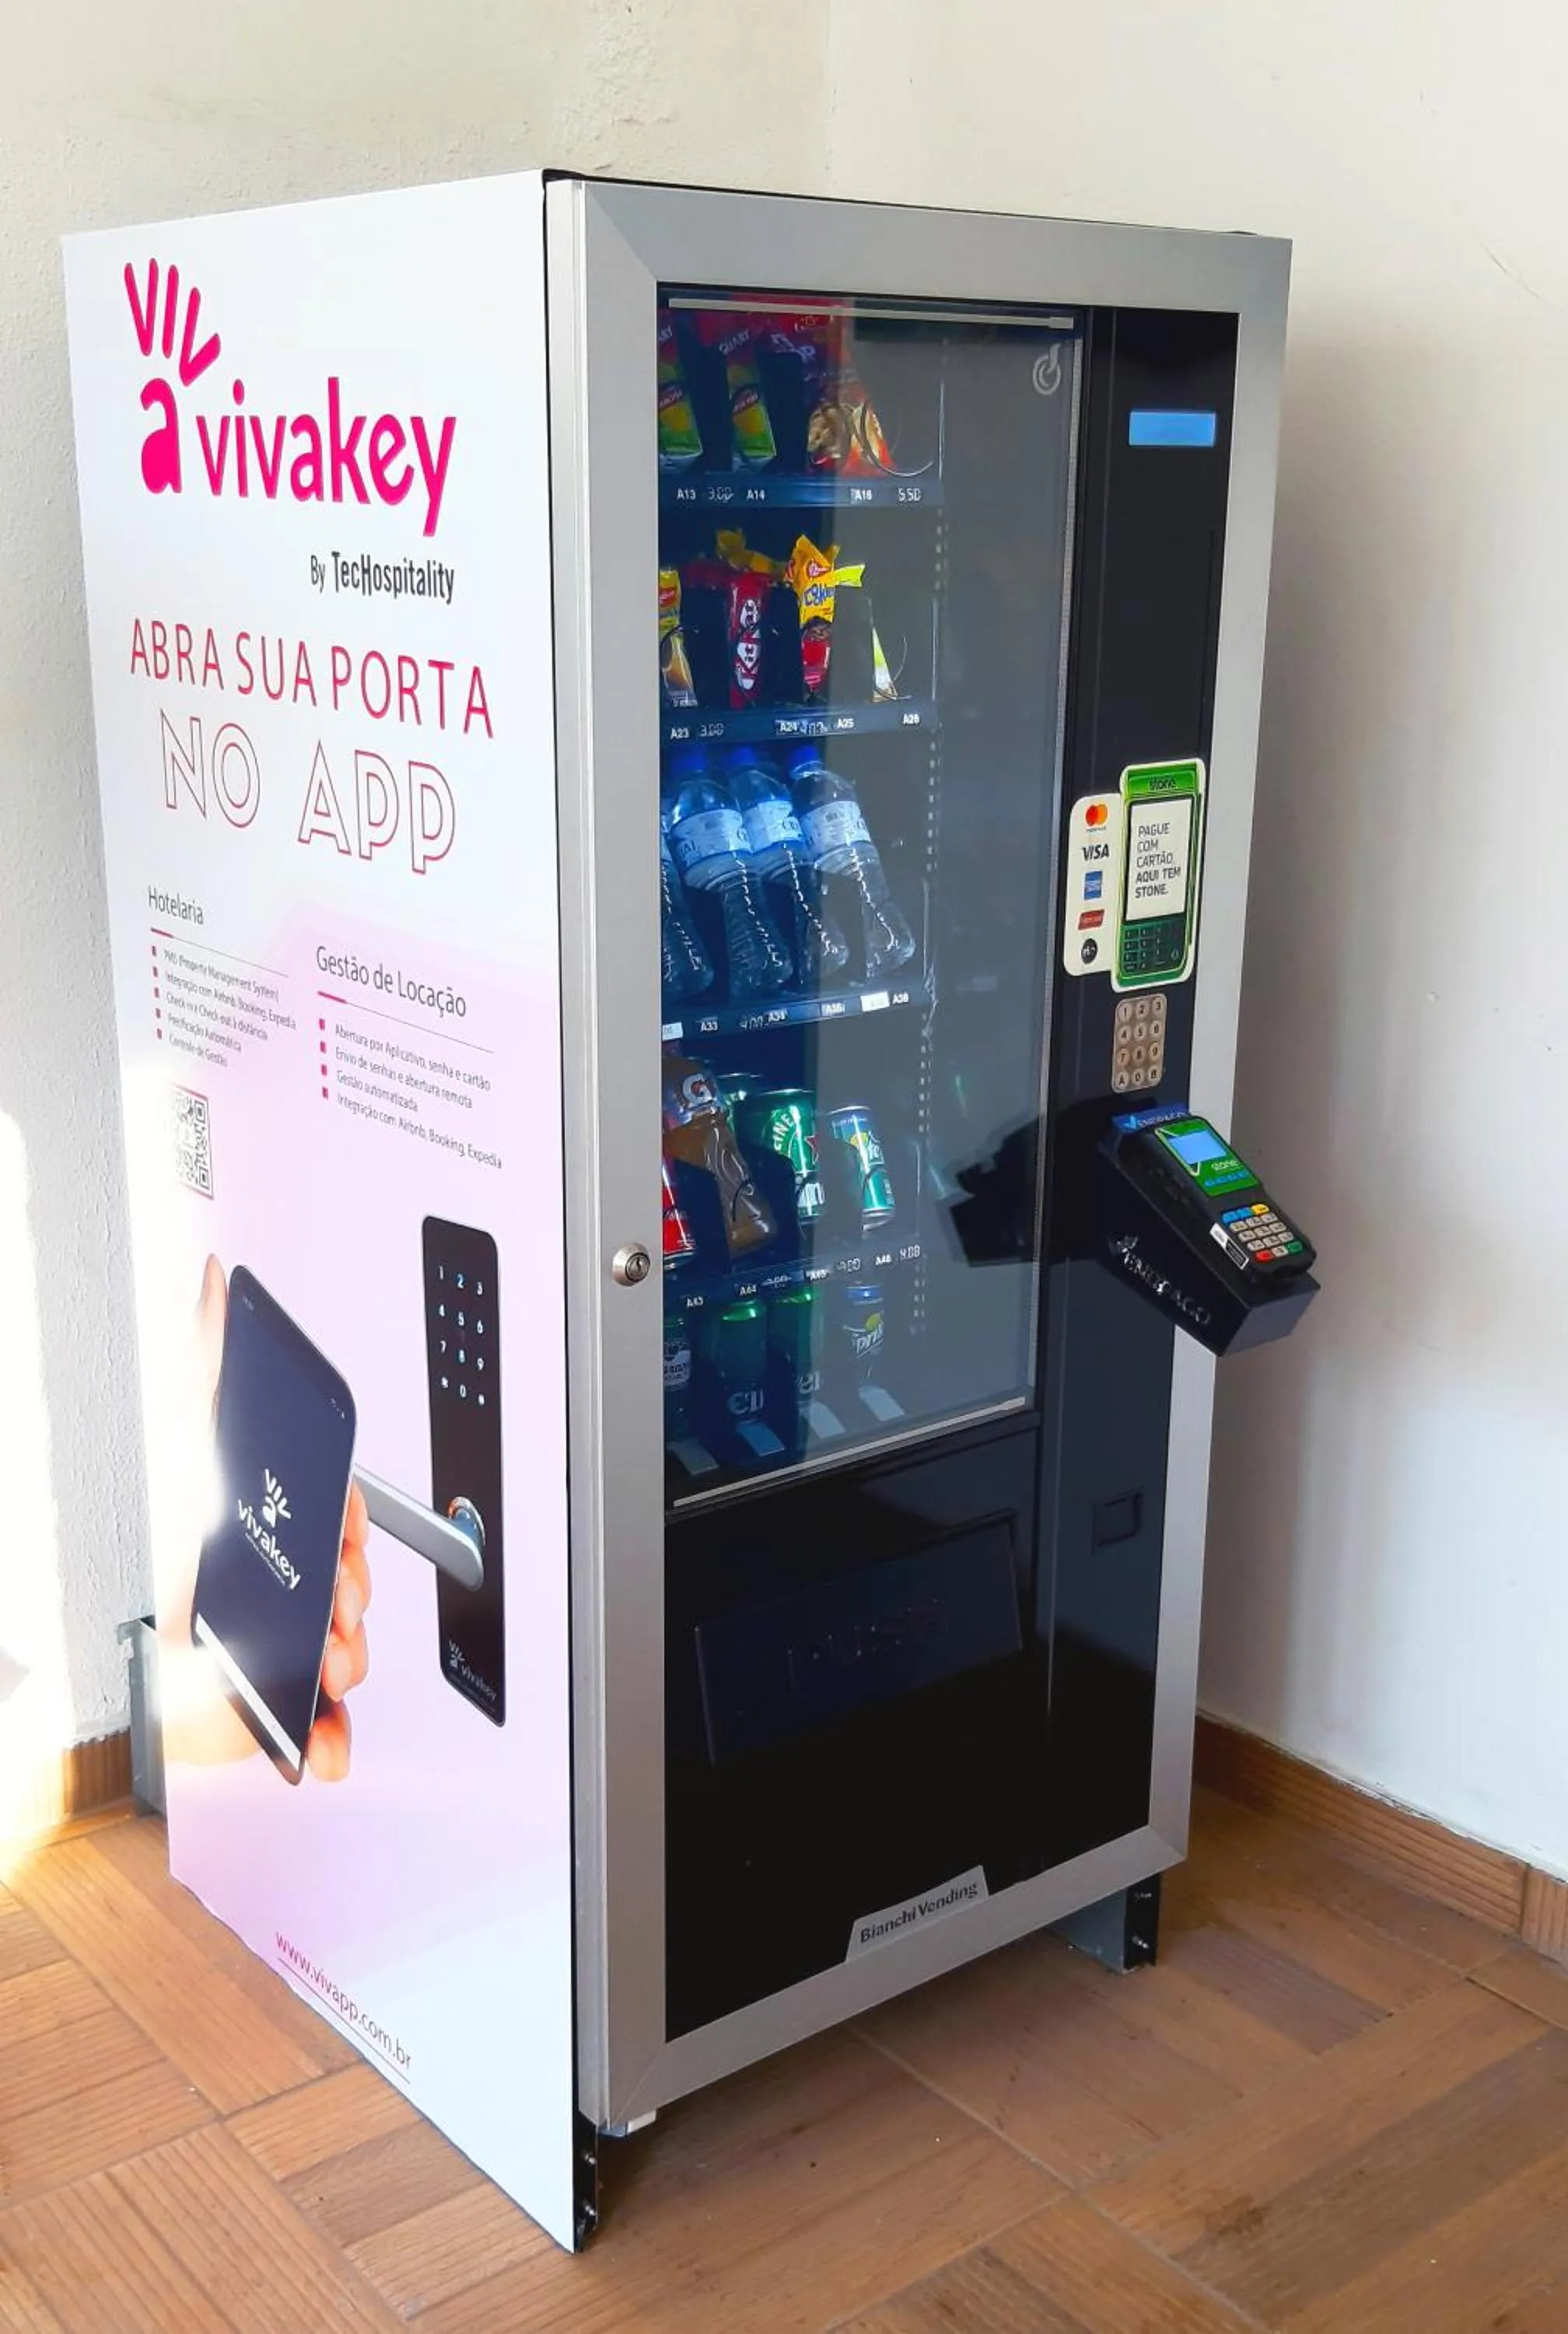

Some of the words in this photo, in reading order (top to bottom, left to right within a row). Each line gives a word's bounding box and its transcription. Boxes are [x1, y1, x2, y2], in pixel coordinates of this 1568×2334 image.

[195, 377, 457, 537] vivakey
[677, 487, 696, 500] A13
[747, 488, 766, 500] A14
[310, 555, 326, 593] By
[331, 552, 455, 605] TecHospitality
[131, 618, 224, 691] ABRA
[236, 631, 317, 707] SUA
[331, 645, 494, 739] PORTA
[670, 727, 690, 740] A23
[837, 718, 854, 729] A25
[159, 708, 261, 829] NO
[298, 739, 456, 875] APP
[1137, 839, 1159, 853] COM
[1138, 822, 1171, 838] PAGUE
[1082, 843, 1110, 862] VISA
[1136, 869, 1160, 885] AQUI
[1162, 865, 1181, 880] TEM
[149, 885, 205, 926] Hotelaria
[317, 945, 369, 986] Gestão
[373, 962, 394, 994] de
[397, 970, 467, 1018] Locação
[701, 1020, 718, 1033] A33
[335, 1023, 368, 1046] Abertura
[369, 1039, 383, 1053] por
[429, 1059, 453, 1078] senha
[463, 1071, 491, 1092] cartão
[358, 1054, 368, 1071] de
[369, 1061, 397, 1081] senhas
[404, 1073, 440, 1098] abertura
[442, 1088, 473, 1109] remota
[364, 1081, 418, 1113] automatizada
[379, 1111, 396, 1127] com
[467, 1143, 502, 1169] Expedia
[457, 1273, 464, 1289] 2
[477, 1281, 483, 1295] 3
[439, 1304, 445, 1317] 4
[458, 1311, 464, 1326] 5
[477, 1319, 484, 1334] 6
[440, 1340, 446, 1353] 7
[459, 1348, 465, 1363] 8
[477, 1358, 484, 1371] 9
[460, 1384, 467, 1398] 0
[236, 1498, 301, 1590] vivakey
[860, 1907, 916, 1944] Bianchi
[917, 1882, 978, 1916] Vending
[275, 1931, 411, 2069] www.vivapp.com.br
